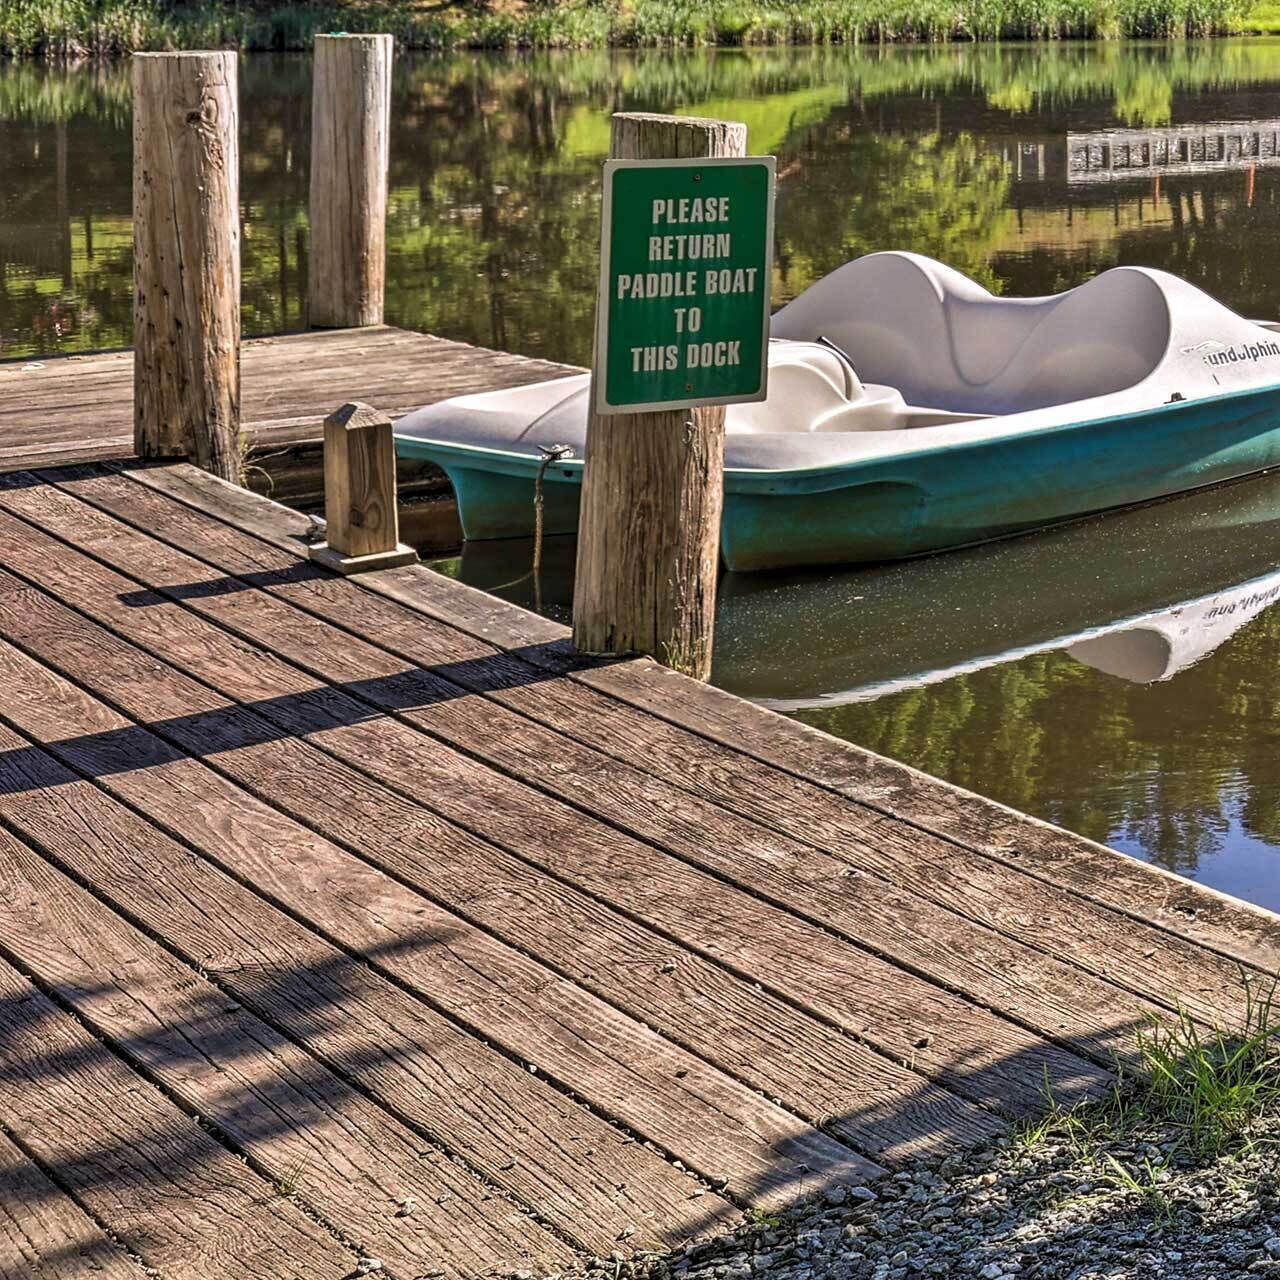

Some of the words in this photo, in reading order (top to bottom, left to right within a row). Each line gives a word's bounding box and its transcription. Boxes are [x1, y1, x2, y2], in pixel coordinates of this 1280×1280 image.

[652, 197, 730, 224] PLEASE
[649, 233, 731, 260] RETURN
[617, 271, 697, 299] PADDLE
[705, 268, 758, 295] BOAT
[674, 307, 701, 333] TO
[631, 345, 678, 372] THIS
[686, 341, 741, 369] DOCK
[1203, 341, 1280, 365] undolphin
